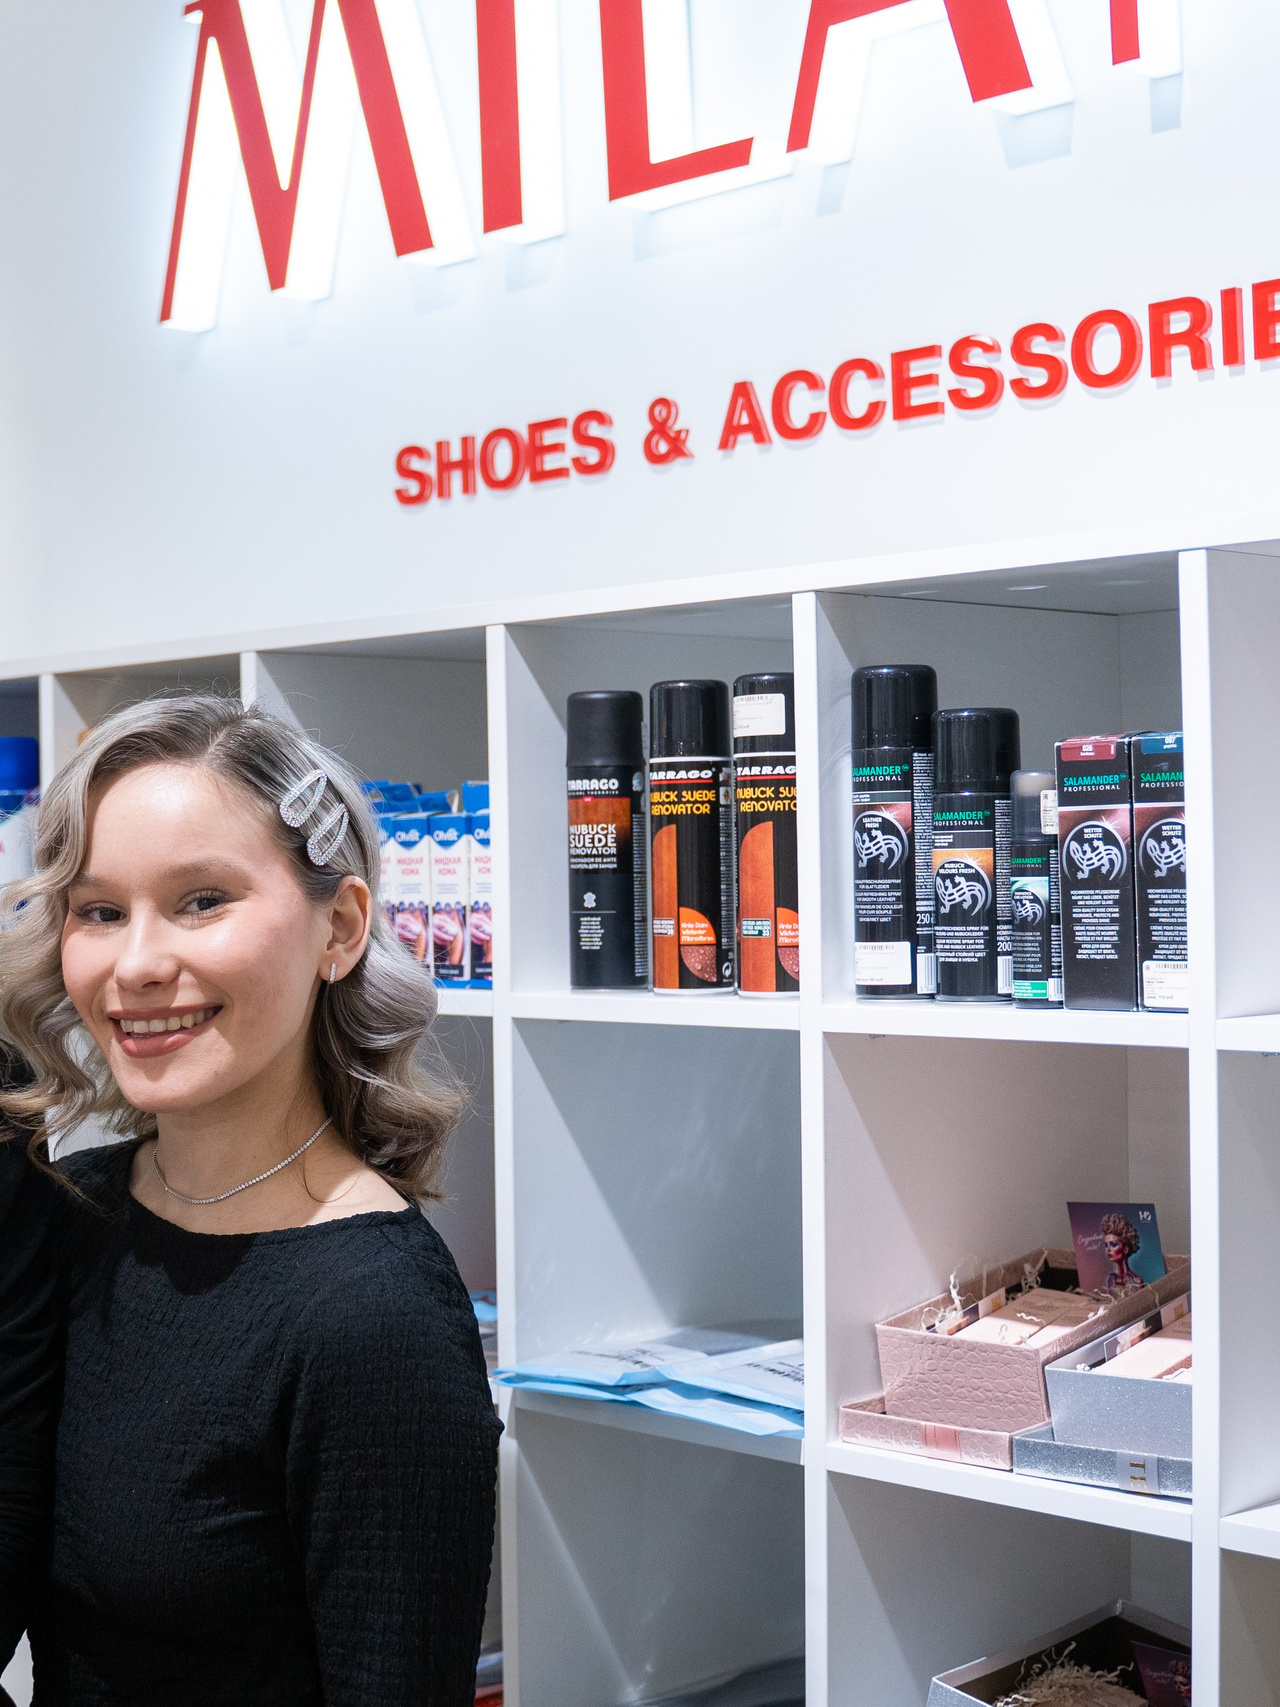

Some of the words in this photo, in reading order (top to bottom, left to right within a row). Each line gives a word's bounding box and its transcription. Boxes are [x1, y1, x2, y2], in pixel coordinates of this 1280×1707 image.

[159, 0, 1144, 325] MIL
[393, 409, 616, 508] SHOES
[642, 397, 694, 467] &
[852, 775, 902, 783] ROFESSIONAL
[1063, 774, 1120, 786] SALAMANDER
[1141, 772, 1183, 782] SALAMAN
[567, 778, 619, 791] TARRAGO
[1063, 785, 1120, 793] PROFESSIONAL
[681, 790, 716, 801] SUEDE
[736, 787, 775, 799] NUBUCK
[651, 803, 710, 816] RENOVATOR
[569, 823, 617, 835] NUBUCK
[569, 834, 617, 847] SUEDE
[397, 856, 424, 866] ЖИДКАЯ
[434, 856, 461, 865] ЖИДКАЯ
[401, 867, 420, 876] КОЖА
[438, 867, 457, 876] КОЖА
[916, 913, 930, 924] 250
[997, 941, 1012, 952] 200
